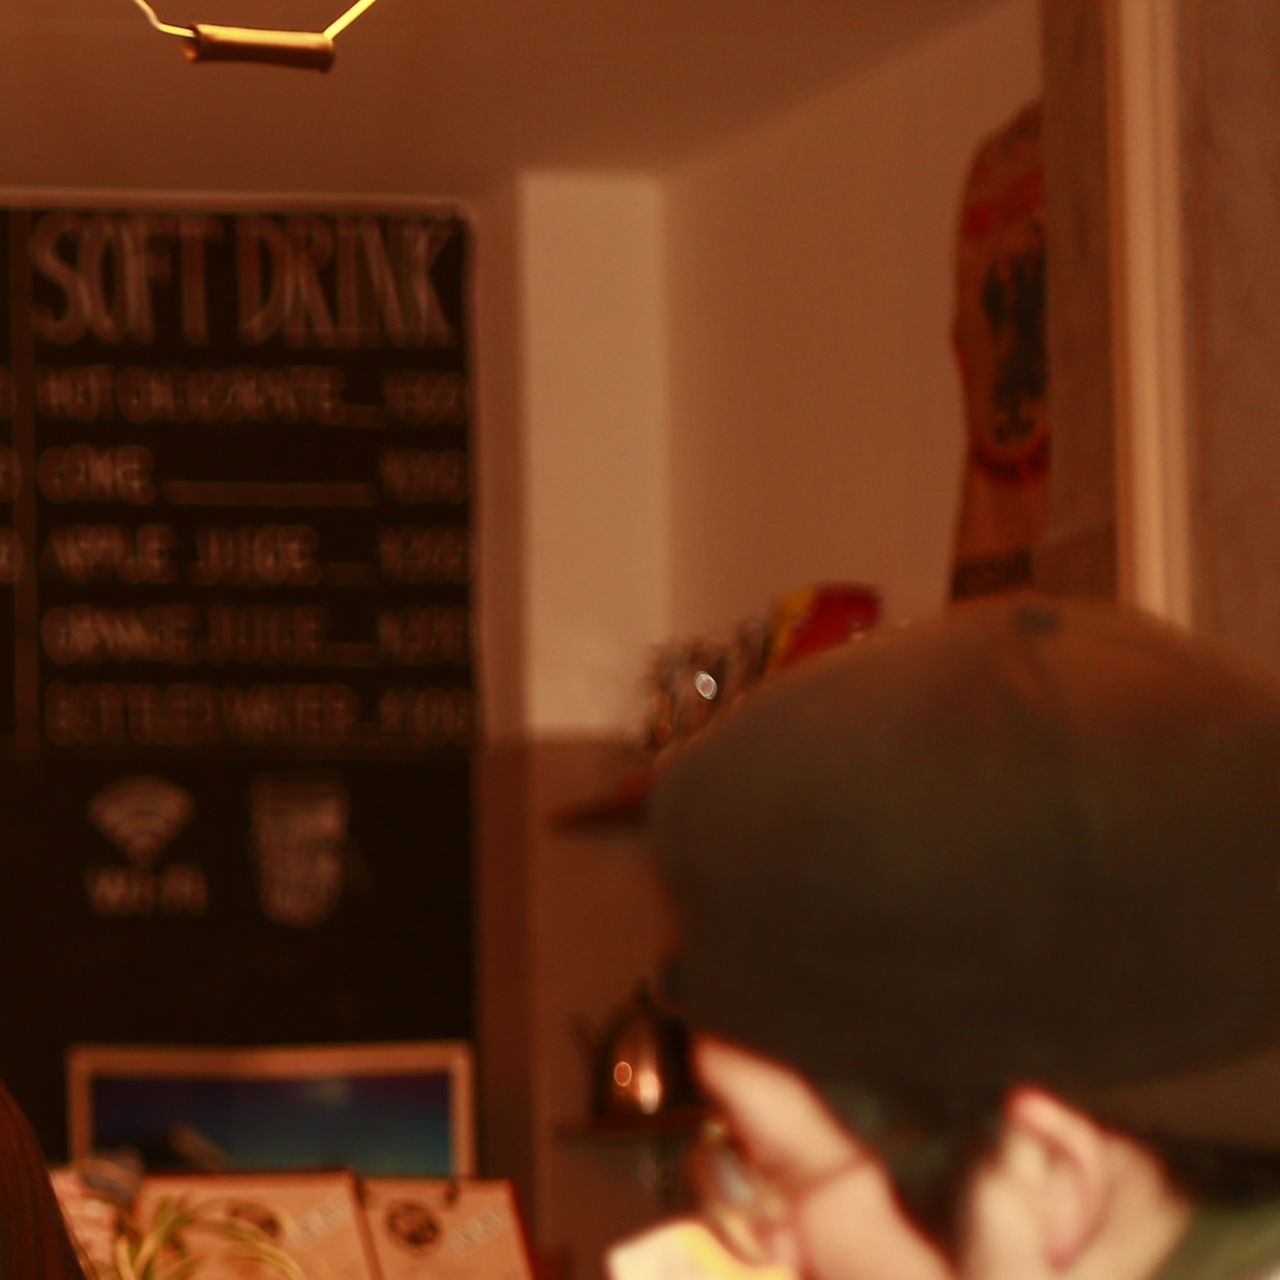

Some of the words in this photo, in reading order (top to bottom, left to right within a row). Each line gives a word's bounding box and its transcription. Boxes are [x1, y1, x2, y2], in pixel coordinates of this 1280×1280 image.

[32, 216, 222, 344] SOFT
[242, 218, 454, 347] DRINK
[190, 526, 319, 584] JUICE
